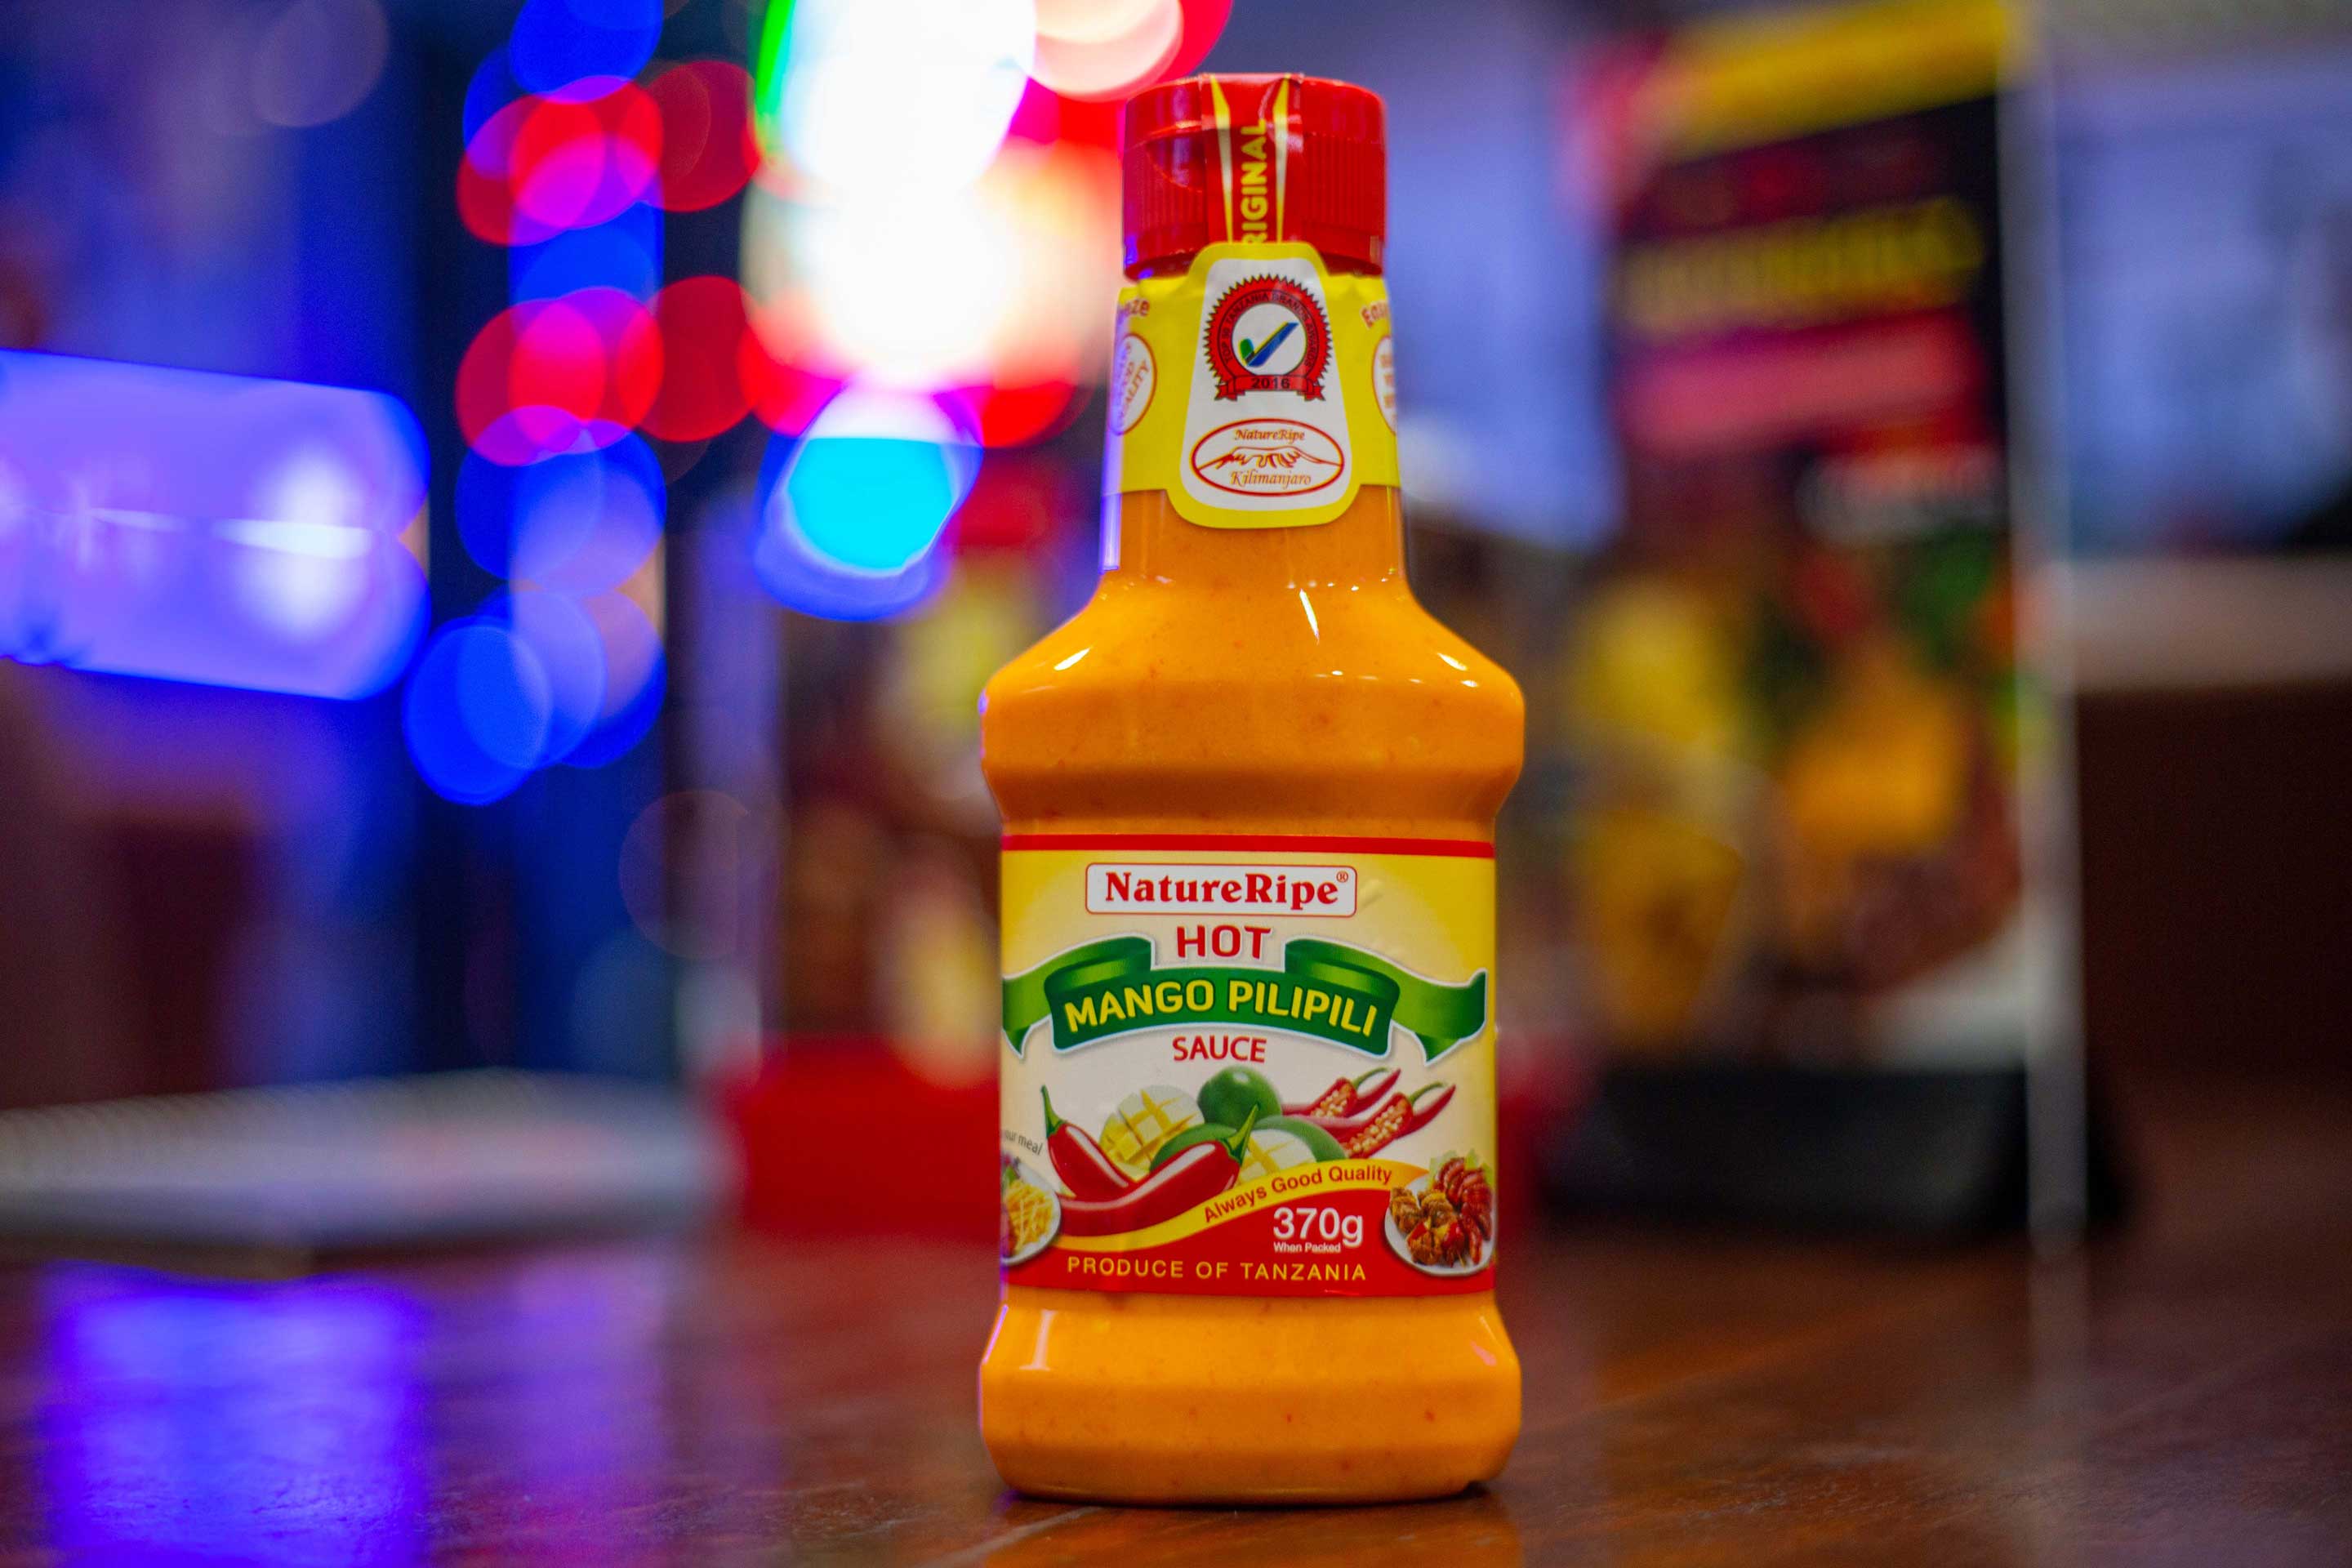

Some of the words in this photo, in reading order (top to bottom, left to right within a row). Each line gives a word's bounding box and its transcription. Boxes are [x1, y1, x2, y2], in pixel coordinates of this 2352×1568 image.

[1241, 118, 1267, 243] RIGINAL
[1226, 293, 1269, 323] TANZANIA
[1250, 378, 1290, 390] 2016
[1234, 429, 1305, 444] NatureRipe
[1230, 468, 1312, 489] Kilimanjaro
[1177, 924, 1272, 960] HOT
[1064, 979, 1214, 1033] MANGO
[1228, 980, 1379, 1037] PILIPILI
[1172, 1035, 1267, 1063] SAUCE
[1018, 1135, 1044, 1156] meal
[1204, 1186, 1267, 1223] Always
[1271, 1168, 1323, 1193] Good
[1328, 1165, 1392, 1185] Quality
[1272, 1206, 1364, 1248] 370g
[1273, 1241, 1303, 1253] When
[1304, 1241, 1341, 1254] Packed
[1067, 1256, 1184, 1278] PRODUCE
[1196, 1262, 1229, 1280] OF
[1240, 1262, 1367, 1281] TANZANIA
